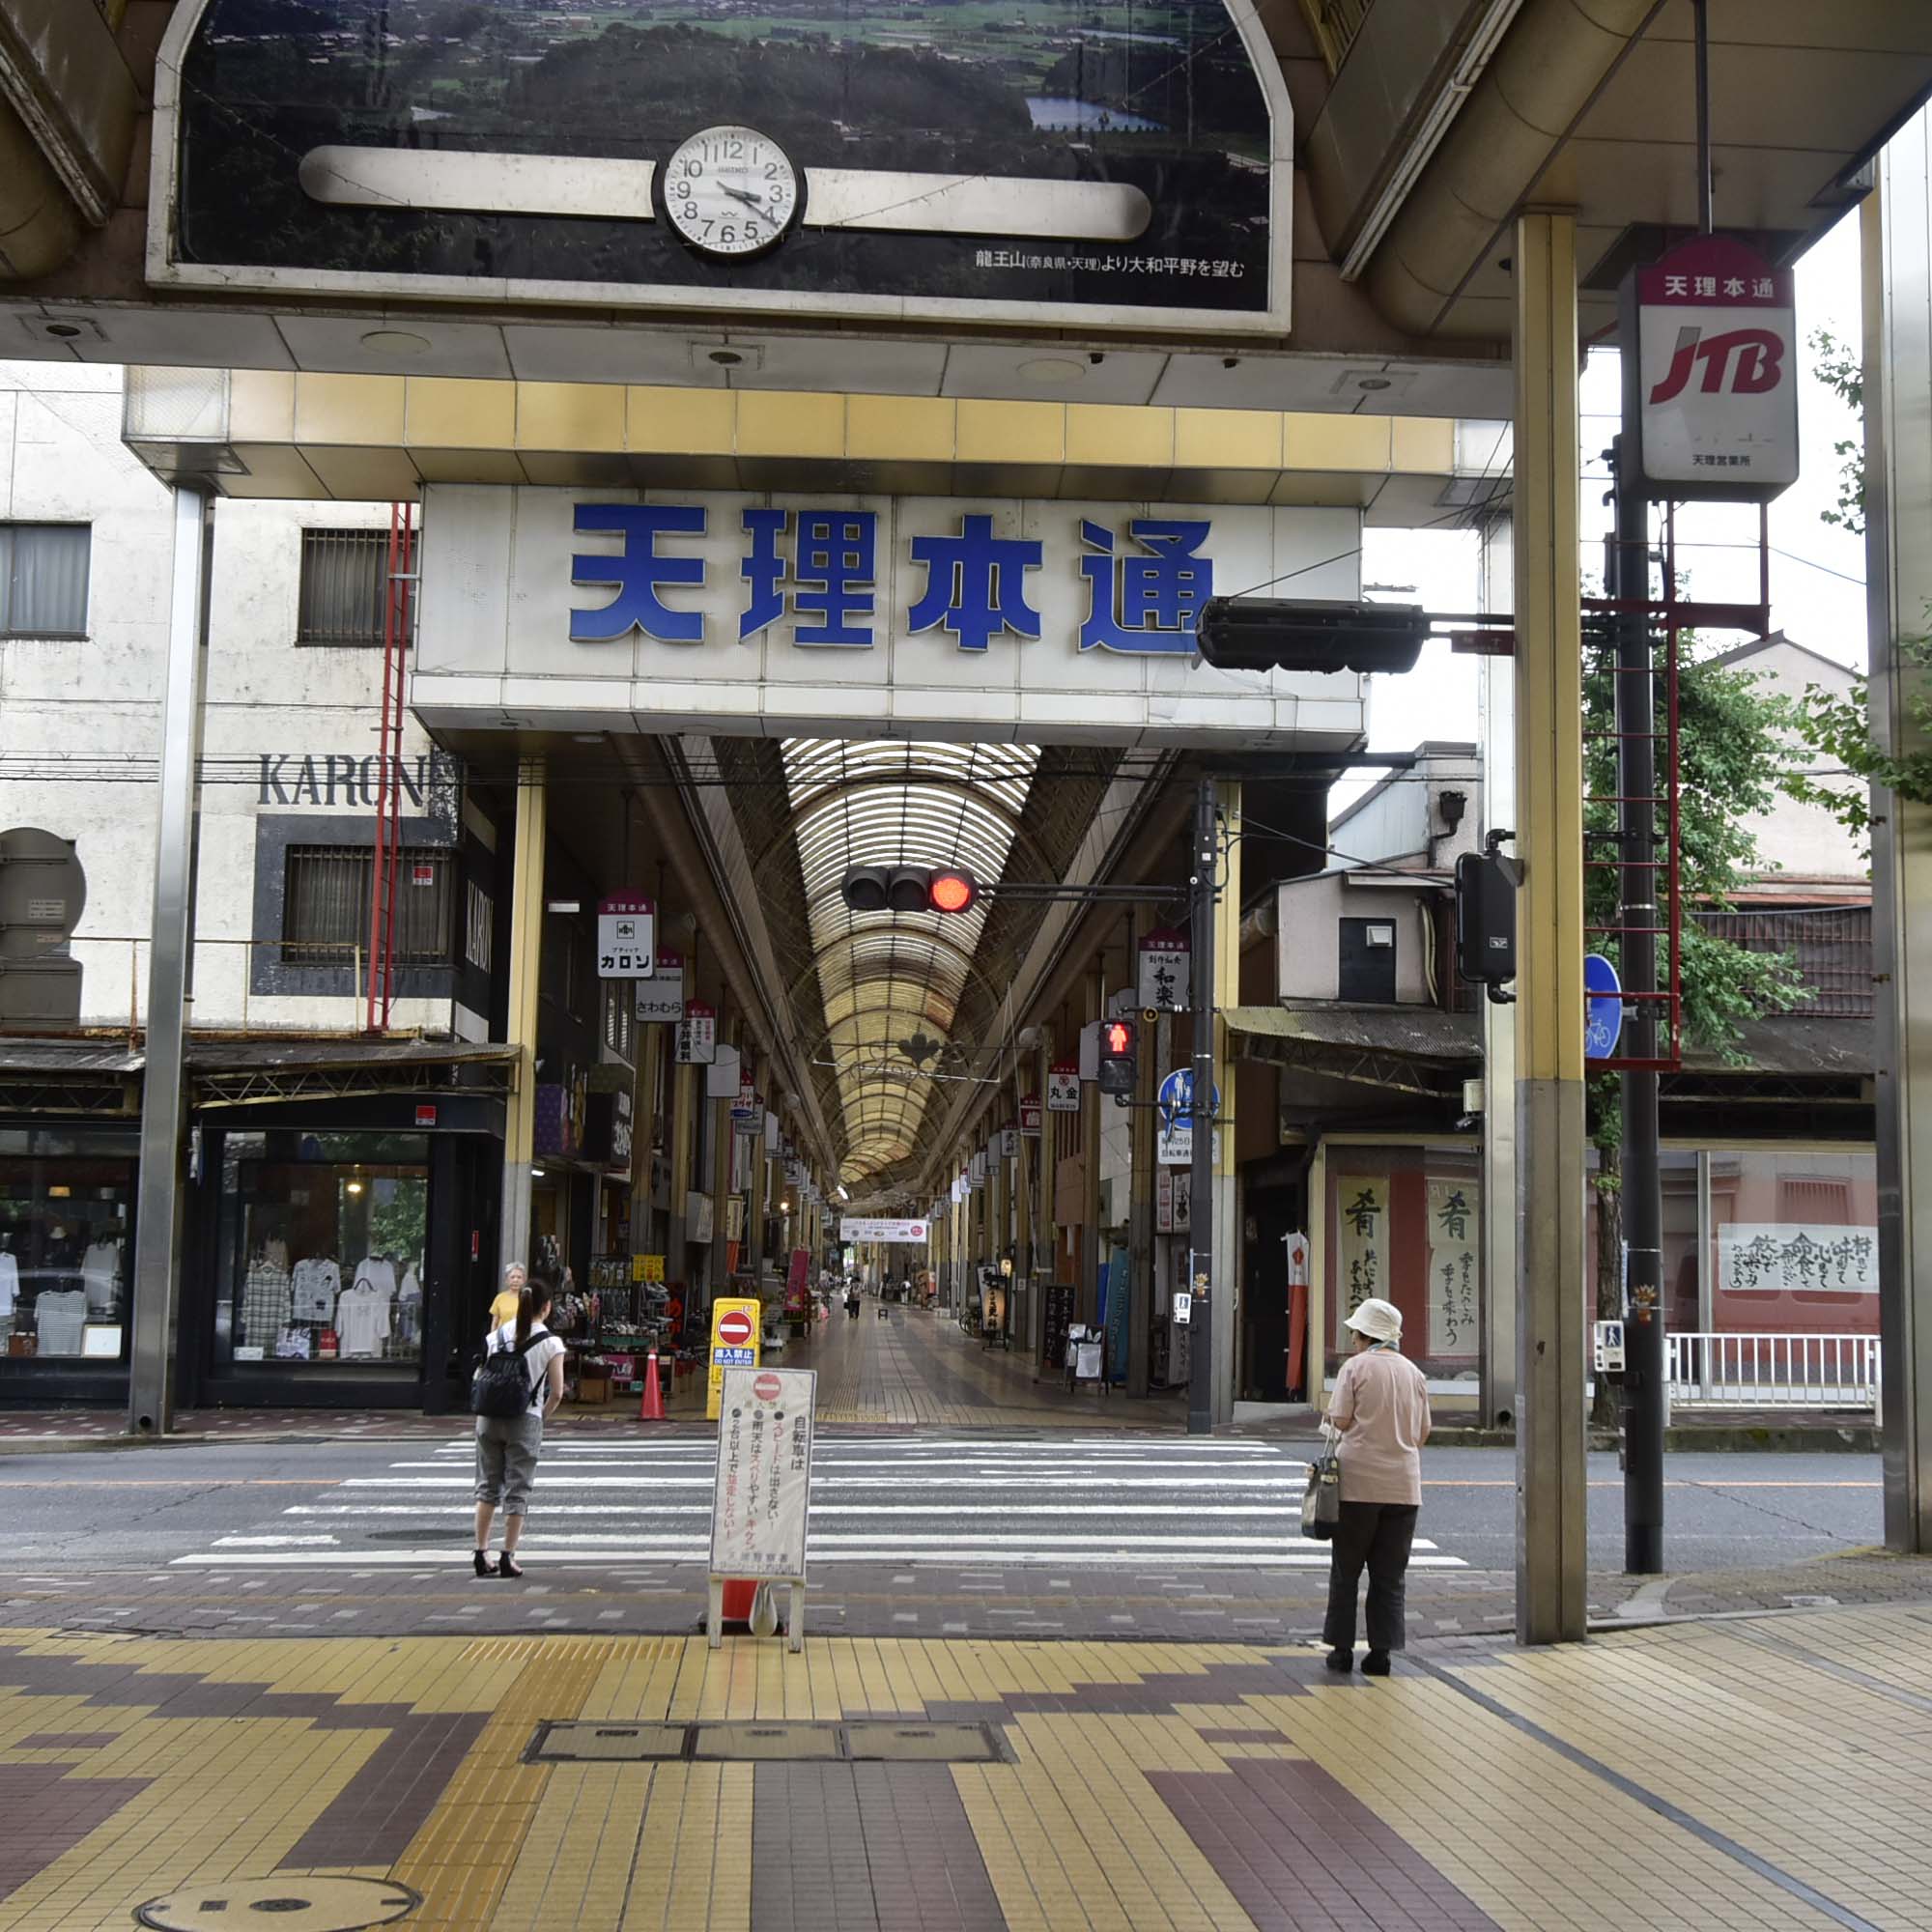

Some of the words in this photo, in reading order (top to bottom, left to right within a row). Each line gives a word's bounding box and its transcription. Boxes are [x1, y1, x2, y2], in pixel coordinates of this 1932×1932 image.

[704, 144, 719, 163] 11
[724, 140, 743, 159] 12
[684, 159, 703, 179] 10
[764, 162, 778, 181] 2
[677, 181, 691, 199] 9
[769, 185, 783, 203] 3
[683, 201, 697, 219] 8
[764, 206, 778, 224] 4
[701, 219, 715, 238] 7
[721, 225, 735, 243] 6
[744, 220, 758, 240] 5
[1665, 275, 1774, 298] 天理本通
[1649, 326, 1785, 405] JTB
[569, 503, 1213, 656] 天理本通
[607, 903, 647, 912] 天理本通
[601, 955, 649, 969] カロン
[1153, 966, 1176, 1005] 和楽
[638, 1001, 681, 1013] さわむら
[1050, 1086, 1077, 1099] 丸金
[1345, 1188, 1381, 1238] 肴
[1436, 1190, 1471, 1240] 肴
[715, 1349, 753, 1358] 進入禁止
[791, 1415, 806, 1470] 自転車は
